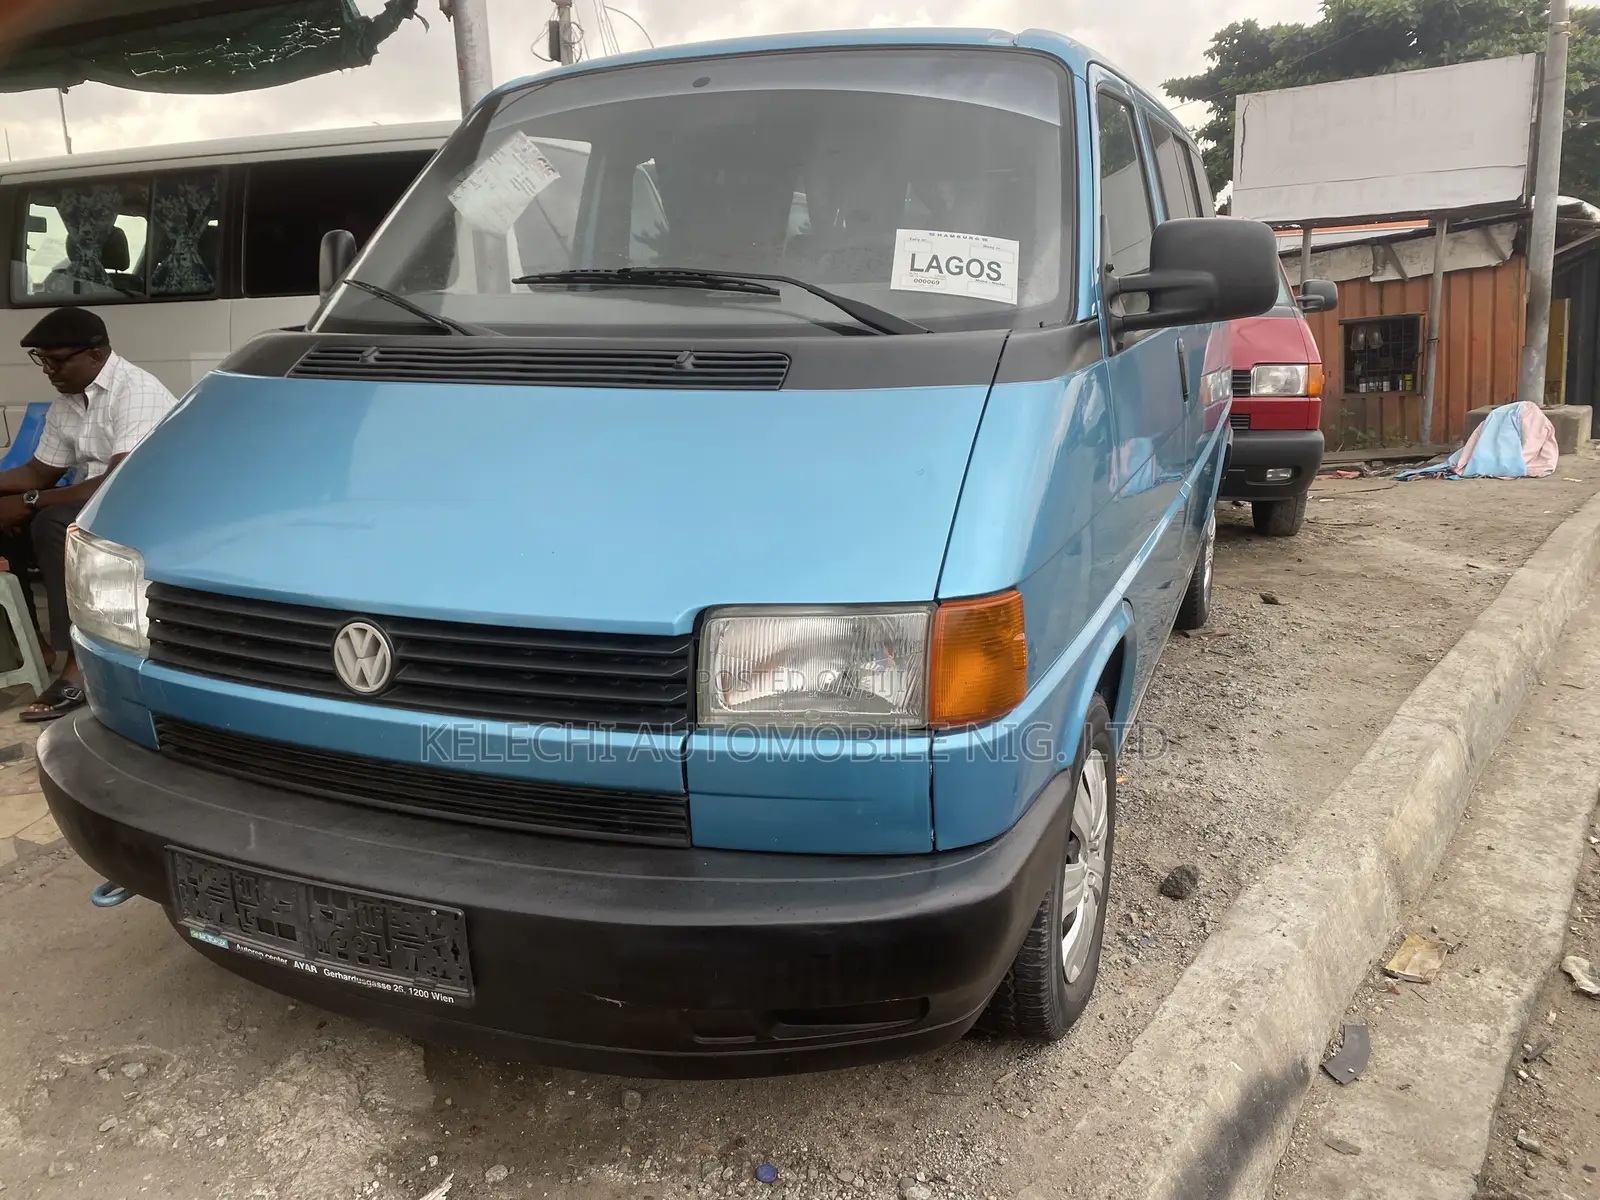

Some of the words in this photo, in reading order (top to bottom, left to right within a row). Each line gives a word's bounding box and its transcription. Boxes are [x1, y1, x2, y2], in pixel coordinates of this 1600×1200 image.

[909, 253, 1002, 282] LAGOS
[293, 960, 318, 974] AYAR
[408, 987, 429, 999] 1200
[431, 991, 455, 1004] Wien
